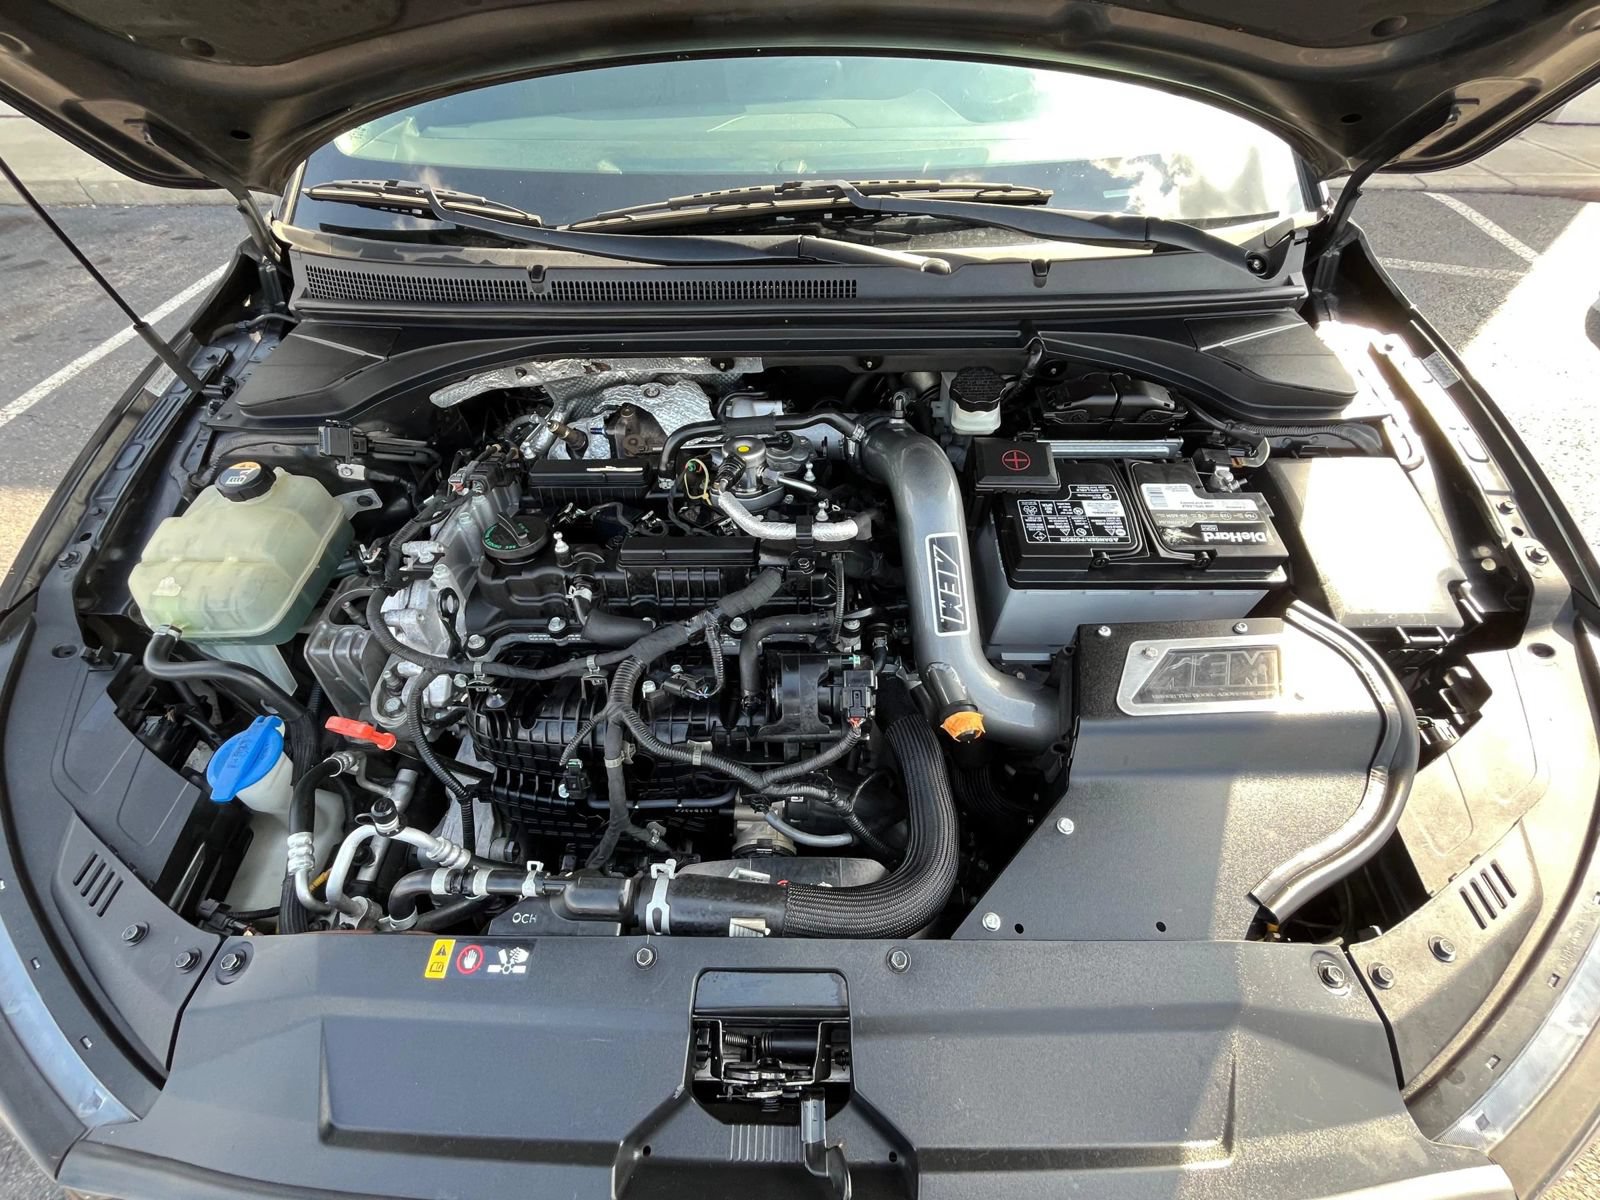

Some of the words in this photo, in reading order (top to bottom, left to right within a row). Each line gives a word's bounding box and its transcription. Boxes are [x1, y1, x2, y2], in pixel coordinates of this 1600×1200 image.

[1201, 530, 1268, 543] DieHard
[932, 544, 965, 624] AEM
[512, 912, 537, 924] OCH
